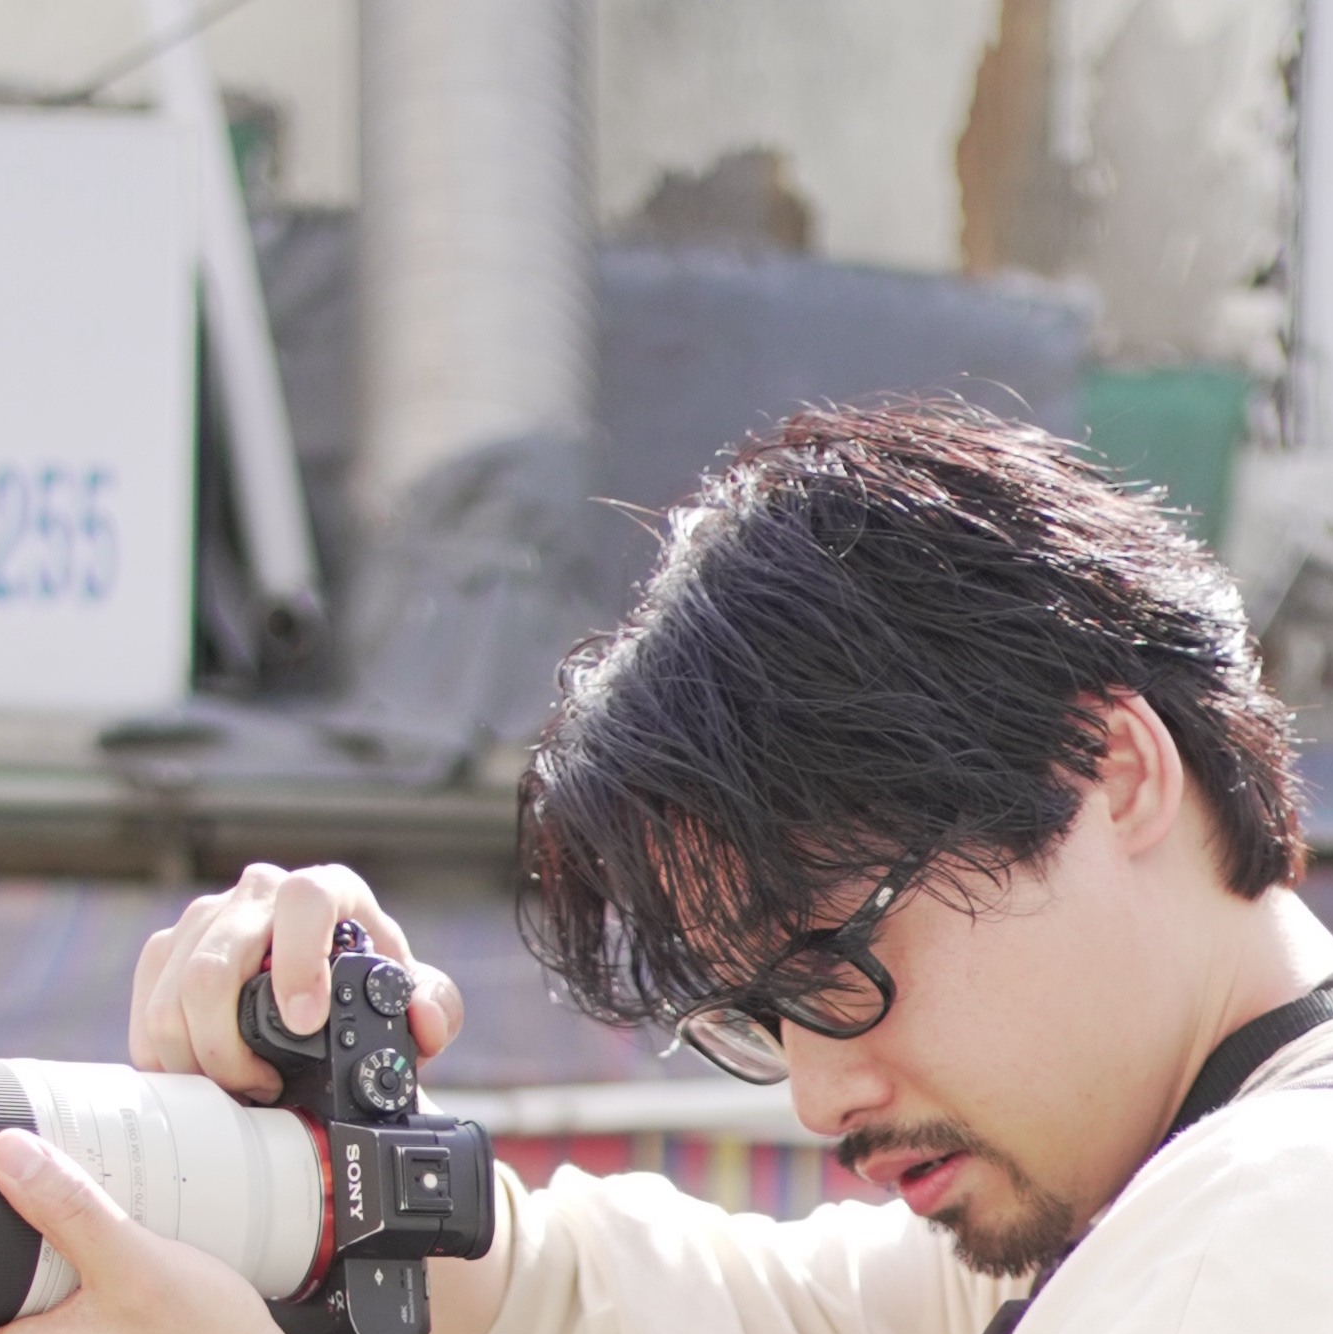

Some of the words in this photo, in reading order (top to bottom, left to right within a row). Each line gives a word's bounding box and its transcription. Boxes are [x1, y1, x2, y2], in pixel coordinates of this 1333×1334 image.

[343, 988, 352, 1001] C1
[345, 1031, 355, 1045] C2
[127, 1122, 138, 1141] OSS
[131, 1144, 142, 1163] GM
[346, 1144, 364, 1221] SONY
